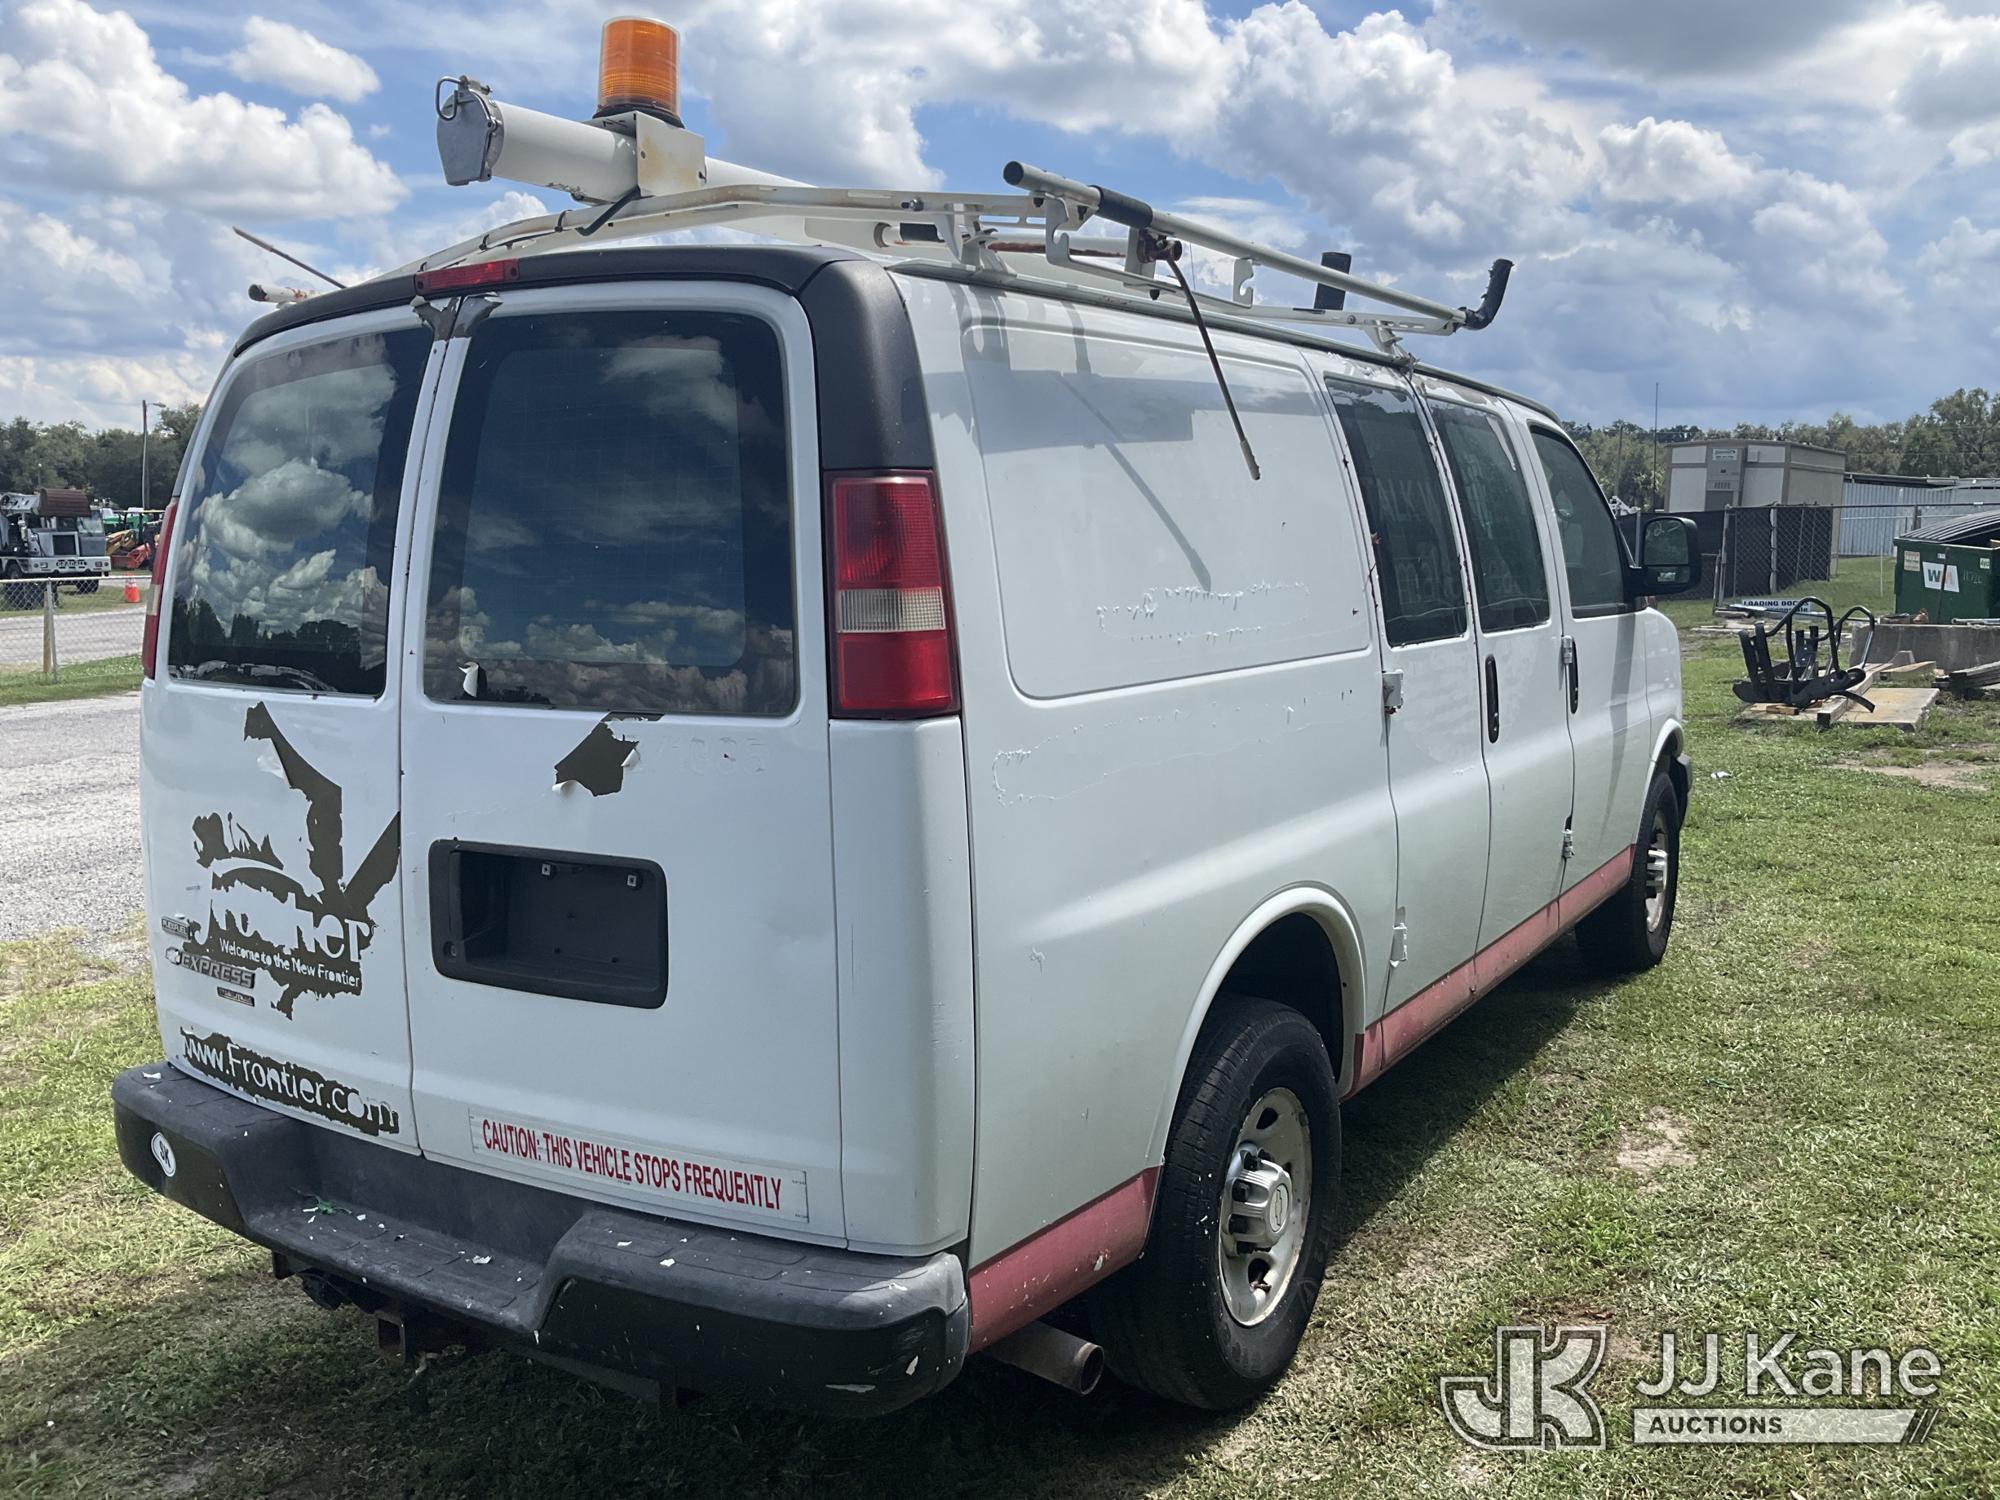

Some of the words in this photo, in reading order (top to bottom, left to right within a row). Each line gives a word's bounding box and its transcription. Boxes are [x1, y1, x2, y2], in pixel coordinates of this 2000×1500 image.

[181, 952, 254, 988] EXPRESS
[219, 937, 260, 962] Welcome
[261, 952, 272, 966] to
[273, 953, 290, 970] the
[291, 957, 315, 978] New
[318, 964, 360, 987] Frontier
[482, 1119, 541, 1161] CAUTION:
[543, 1132, 573, 1168] THIS
[574, 1139, 632, 1182] VEHICLE
[634, 1152, 681, 1192] STOPS
[684, 1162, 782, 1210] FREQUENTLY
